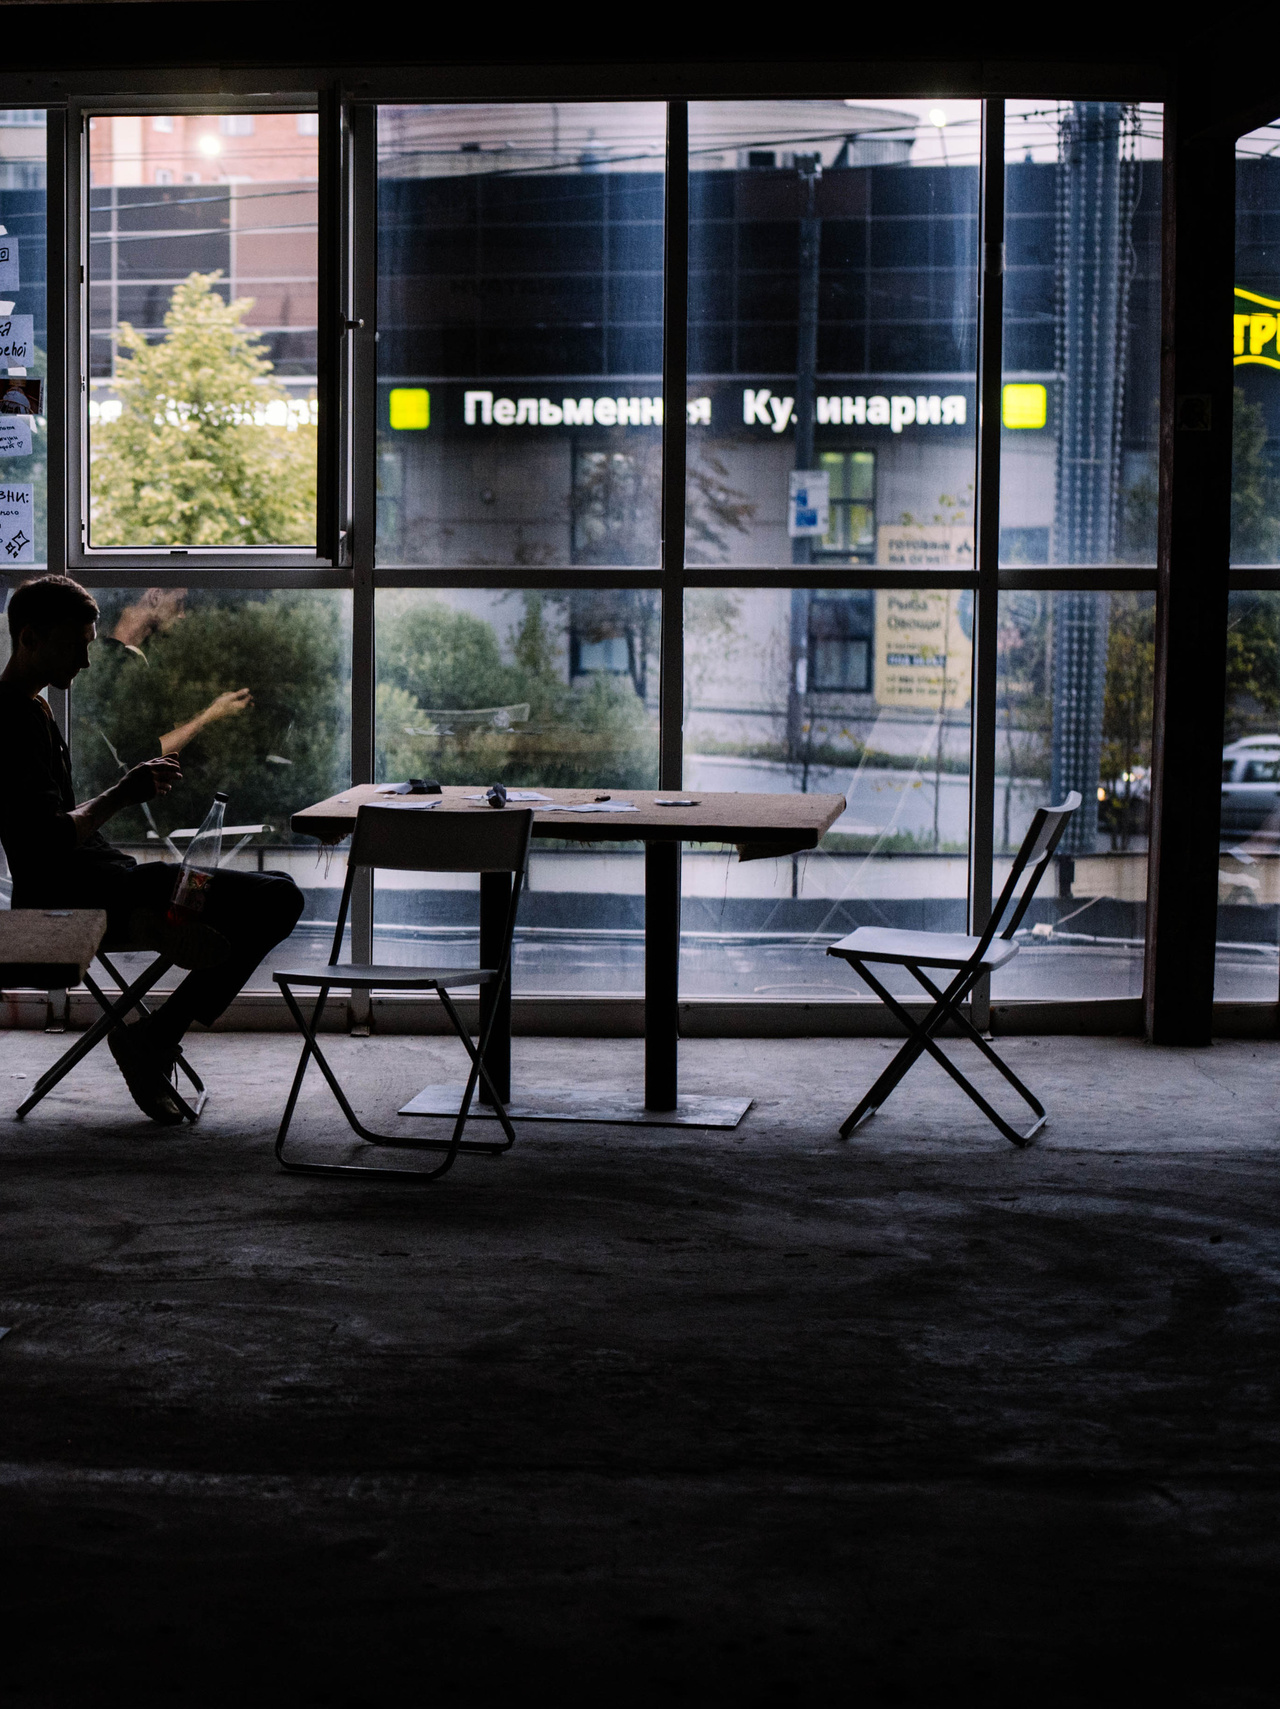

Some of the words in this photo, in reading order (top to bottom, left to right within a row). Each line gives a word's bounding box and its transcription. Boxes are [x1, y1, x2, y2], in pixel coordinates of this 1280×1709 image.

[1233, 313, 1280, 355] ГР
[464, 390, 713, 427] Пельмення
[742, 388, 968, 434] Куинария
